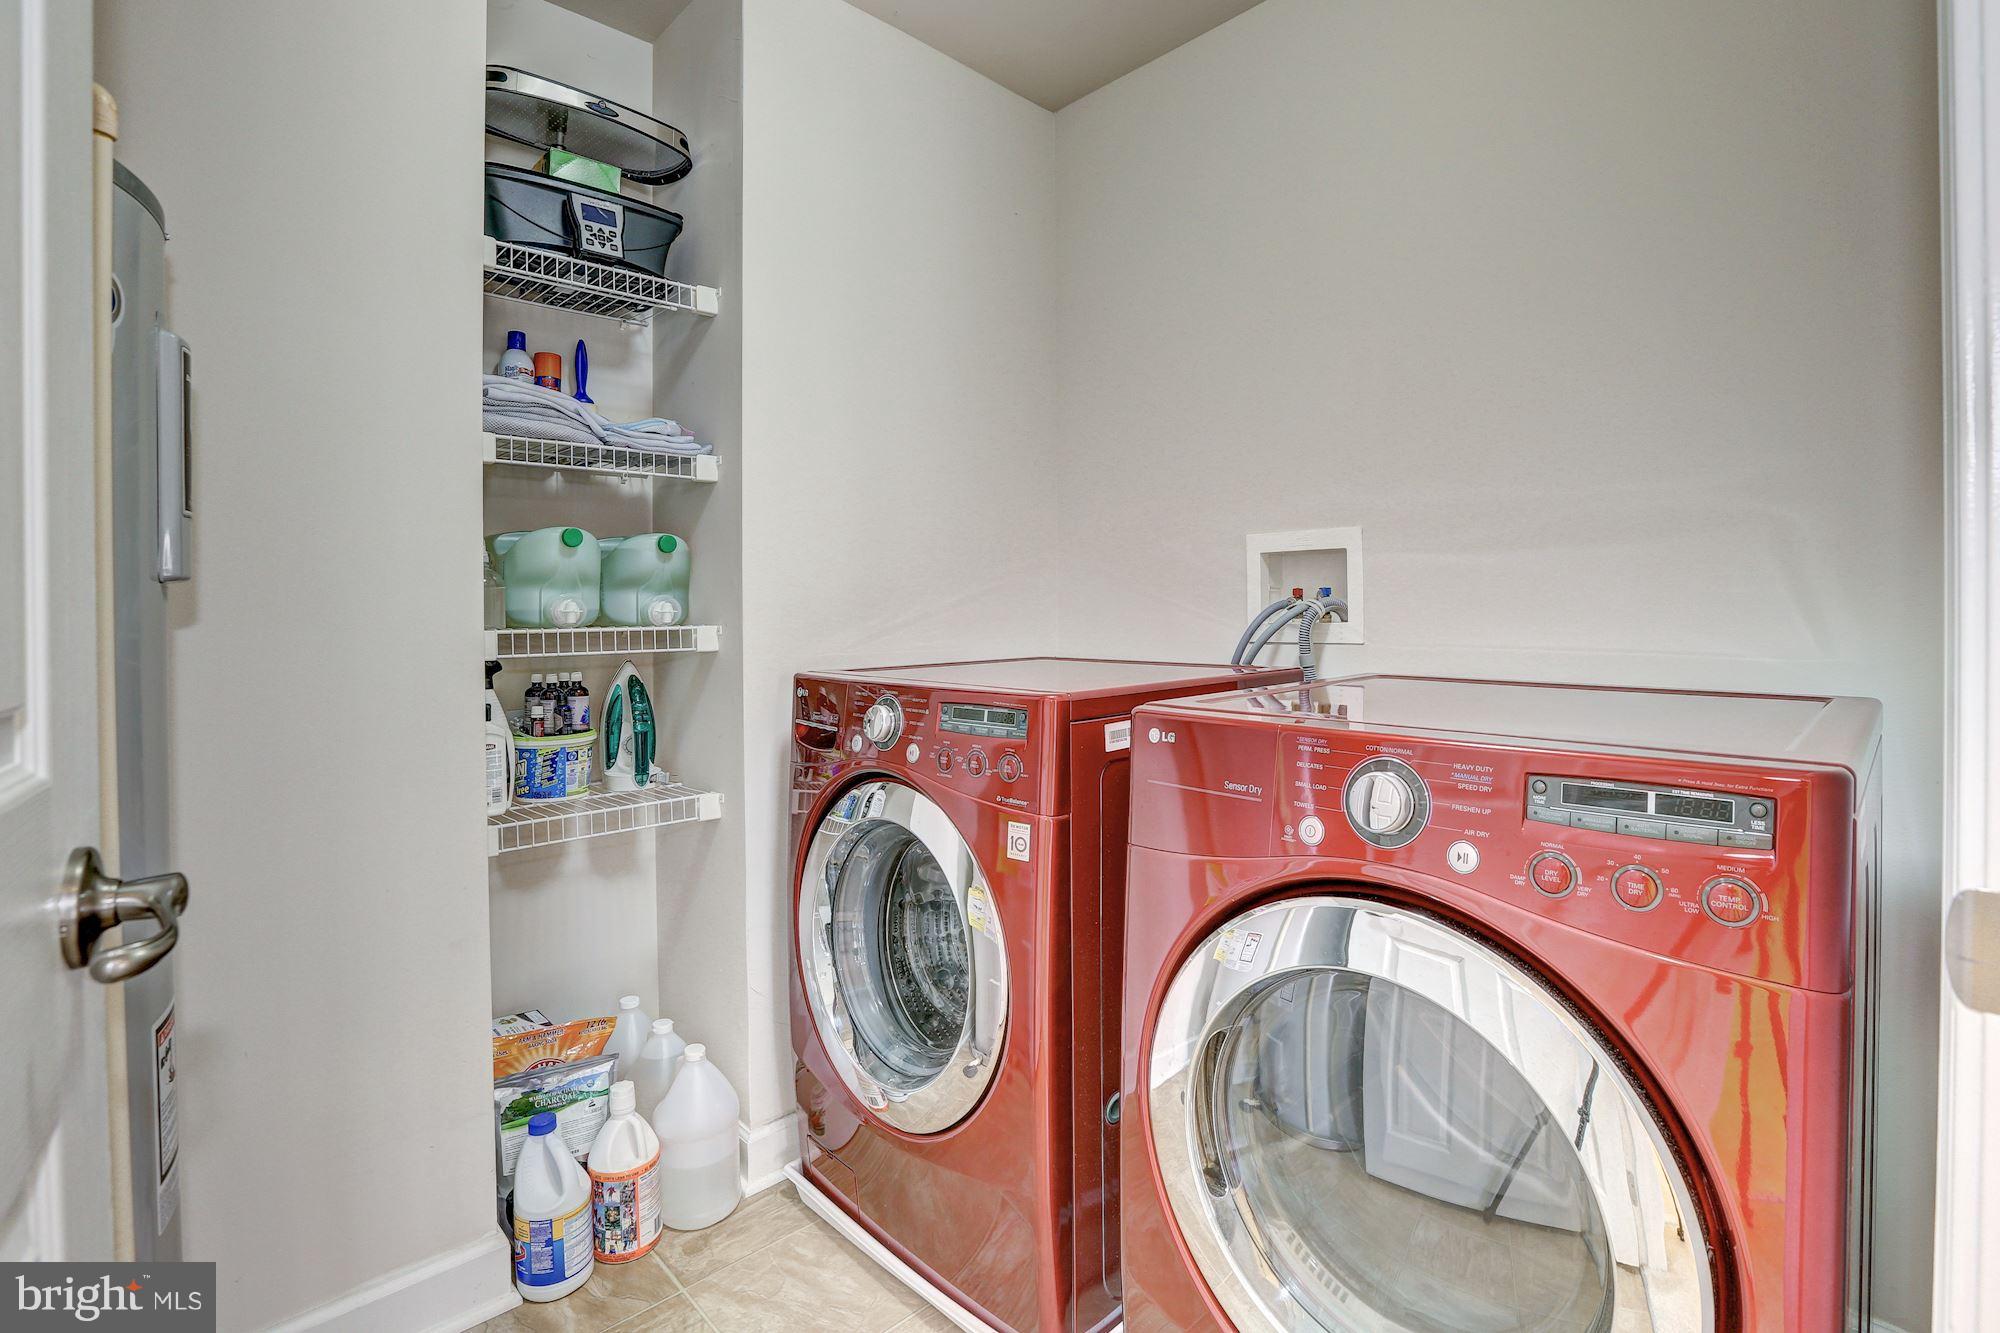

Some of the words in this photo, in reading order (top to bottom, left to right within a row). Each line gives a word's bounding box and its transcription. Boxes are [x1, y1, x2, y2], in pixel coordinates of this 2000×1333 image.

[1161, 731, 1176, 743] LG
[1313, 746, 1331, 754] PRESS
[1296, 761, 1324, 770] DELICATES
[1453, 763, 1475, 771] HEAVY
[1475, 765, 1494, 773] DUTY
[1223, 780, 1248, 792] Sensor
[1248, 783, 1263, 796] Dry
[1295, 781, 1312, 789] SMALL
[1312, 783, 1327, 791] LOAD
[1457, 783, 1478, 791] SPEED
[1479, 785, 1493, 793] DRY
[1293, 801, 1315, 810] TOWELS
[1451, 804, 1481, 814] FRESHEN
[1463, 828, 1475, 836] AIR
[1476, 830, 1490, 838] DRY
[1010, 835, 1027, 853] 10
[1540, 841, 1565, 850] NORMAL
[1544, 869, 1559, 877] DRY
[1716, 864, 1746, 874] MEDIUM
[1541, 875, 1561, 883] LEVEL
[1627, 882, 1645, 890] TIME
[1628, 888, 1643, 896] DRY
[1710, 900, 1749, 912] CONTROL
[1761, 914, 1780, 922] HIGH
[534, 1091, 579, 1108] CHARCOAL
